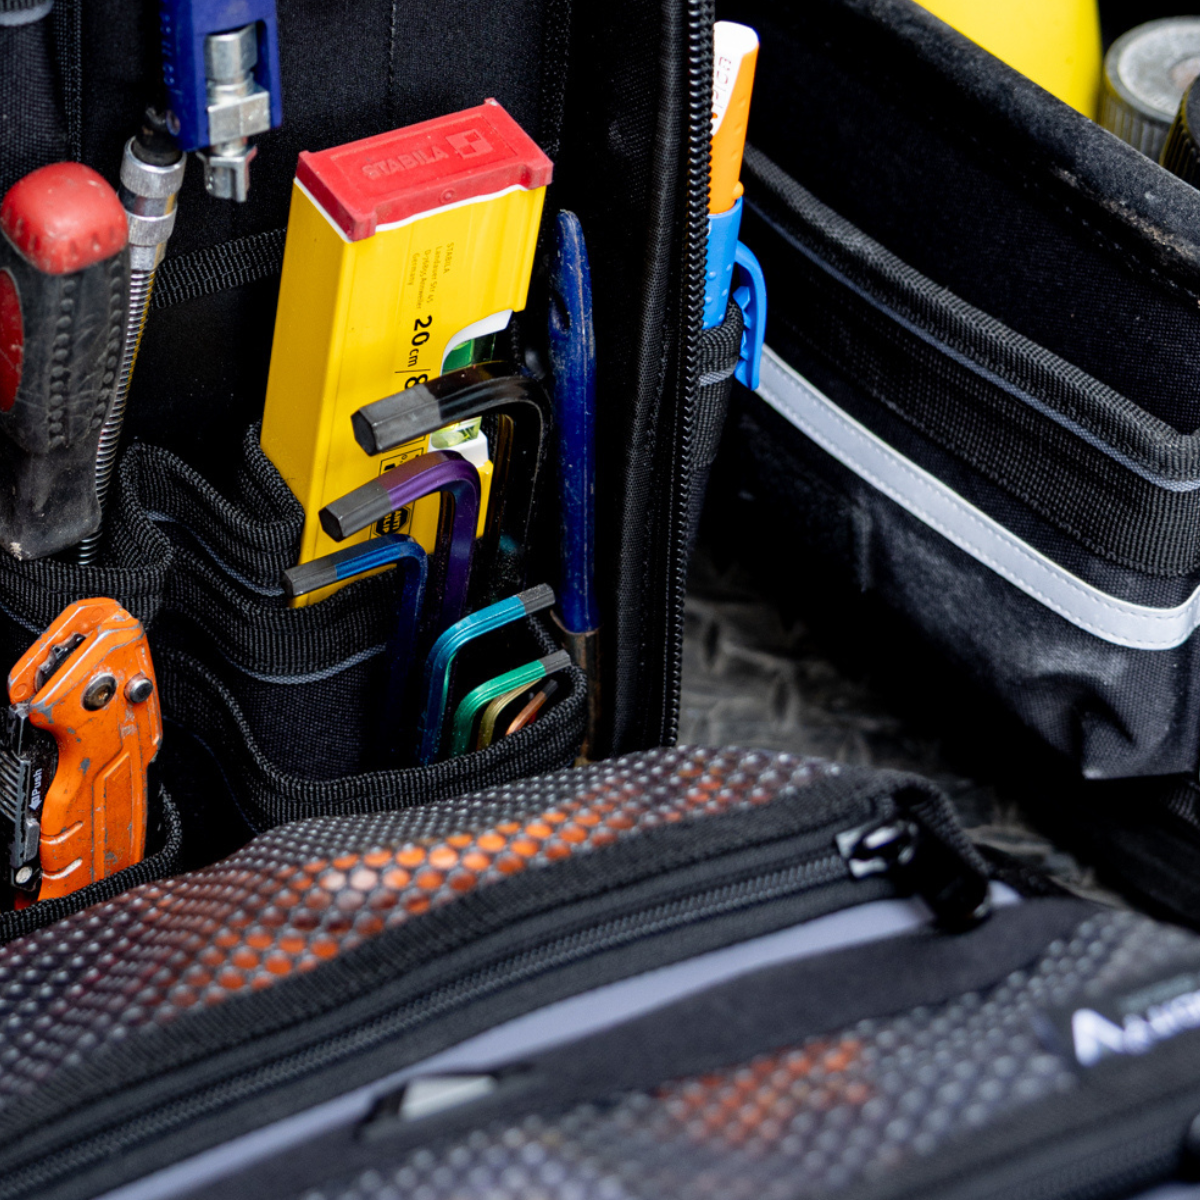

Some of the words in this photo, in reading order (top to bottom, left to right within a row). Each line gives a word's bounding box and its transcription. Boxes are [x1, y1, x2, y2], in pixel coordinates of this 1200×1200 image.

[362, 145, 449, 180] STABILA
[407, 252, 421, 286] Germany
[443, 242, 455, 275] STABILA
[32, 767, 43, 796] Push
